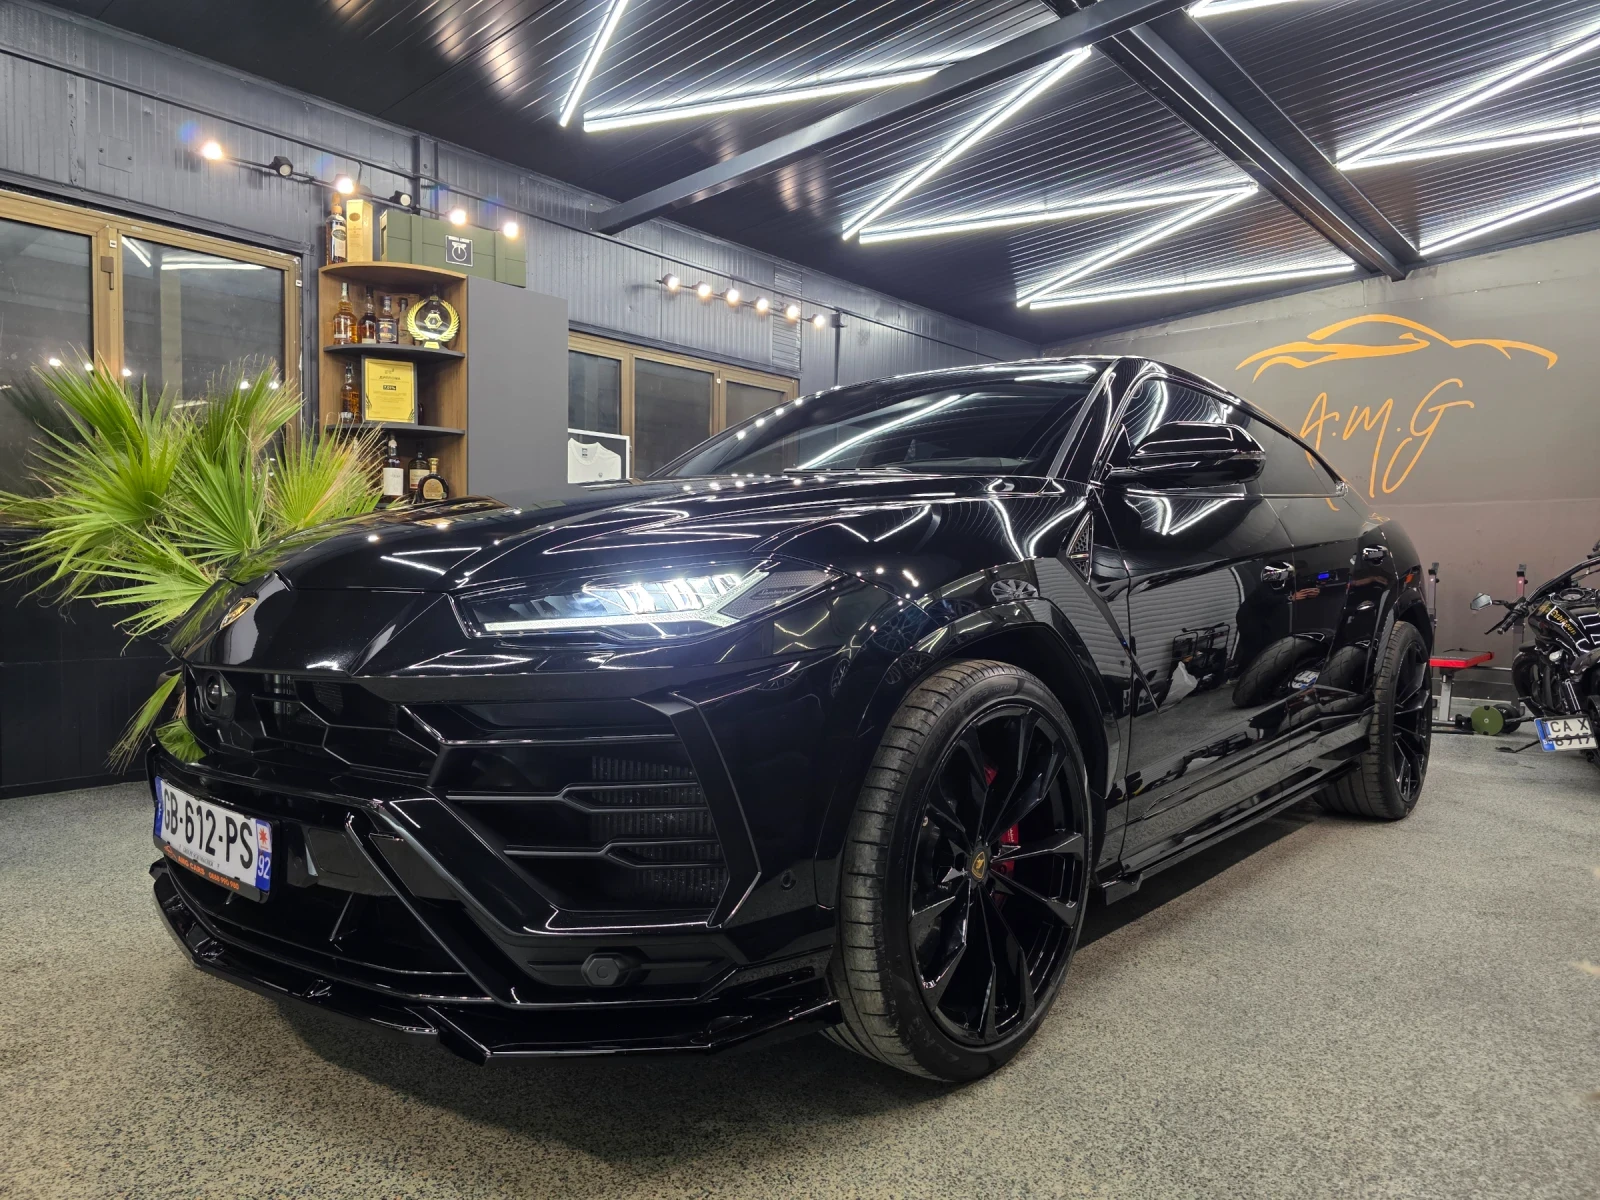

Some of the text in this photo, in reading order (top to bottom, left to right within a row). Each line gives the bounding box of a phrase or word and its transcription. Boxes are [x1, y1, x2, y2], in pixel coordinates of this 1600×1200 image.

[1299, 378, 1475, 498] A.M.G
[1550, 717, 1589, 733] CA X
[164, 788, 254, 870] GB-612-PS
[257, 855, 271, 880] 92
